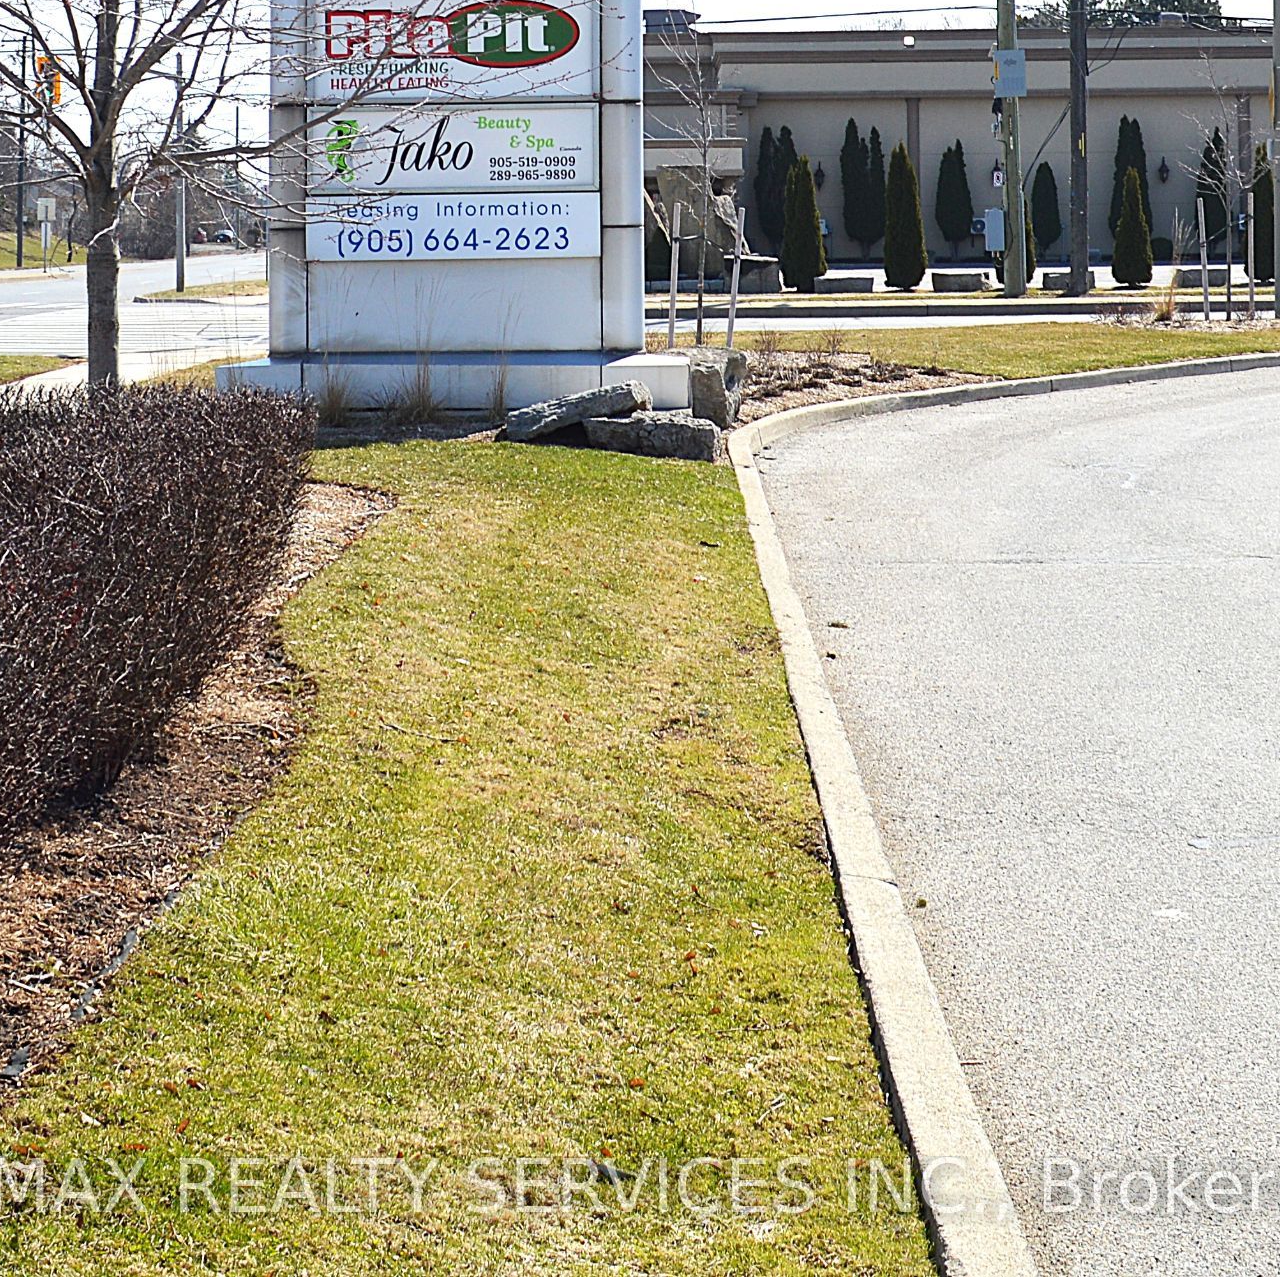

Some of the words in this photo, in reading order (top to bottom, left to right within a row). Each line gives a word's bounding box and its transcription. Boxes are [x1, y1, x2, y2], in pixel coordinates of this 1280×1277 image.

[379, 61, 449, 76] THINKING
[398, 76, 449, 89] EATING
[477, 116, 531, 131] Beauty
[375, 115, 474, 186] Jako
[510, 135, 521, 149] &
[525, 135, 555, 152] Spa
[489, 156, 576, 168] 905-519-0909
[489, 169, 576, 181] 289-965-9890
[436, 201, 570, 217] Information:
[337, 228, 413, 258] (905)
[423, 227, 570, 251] 664-2623
